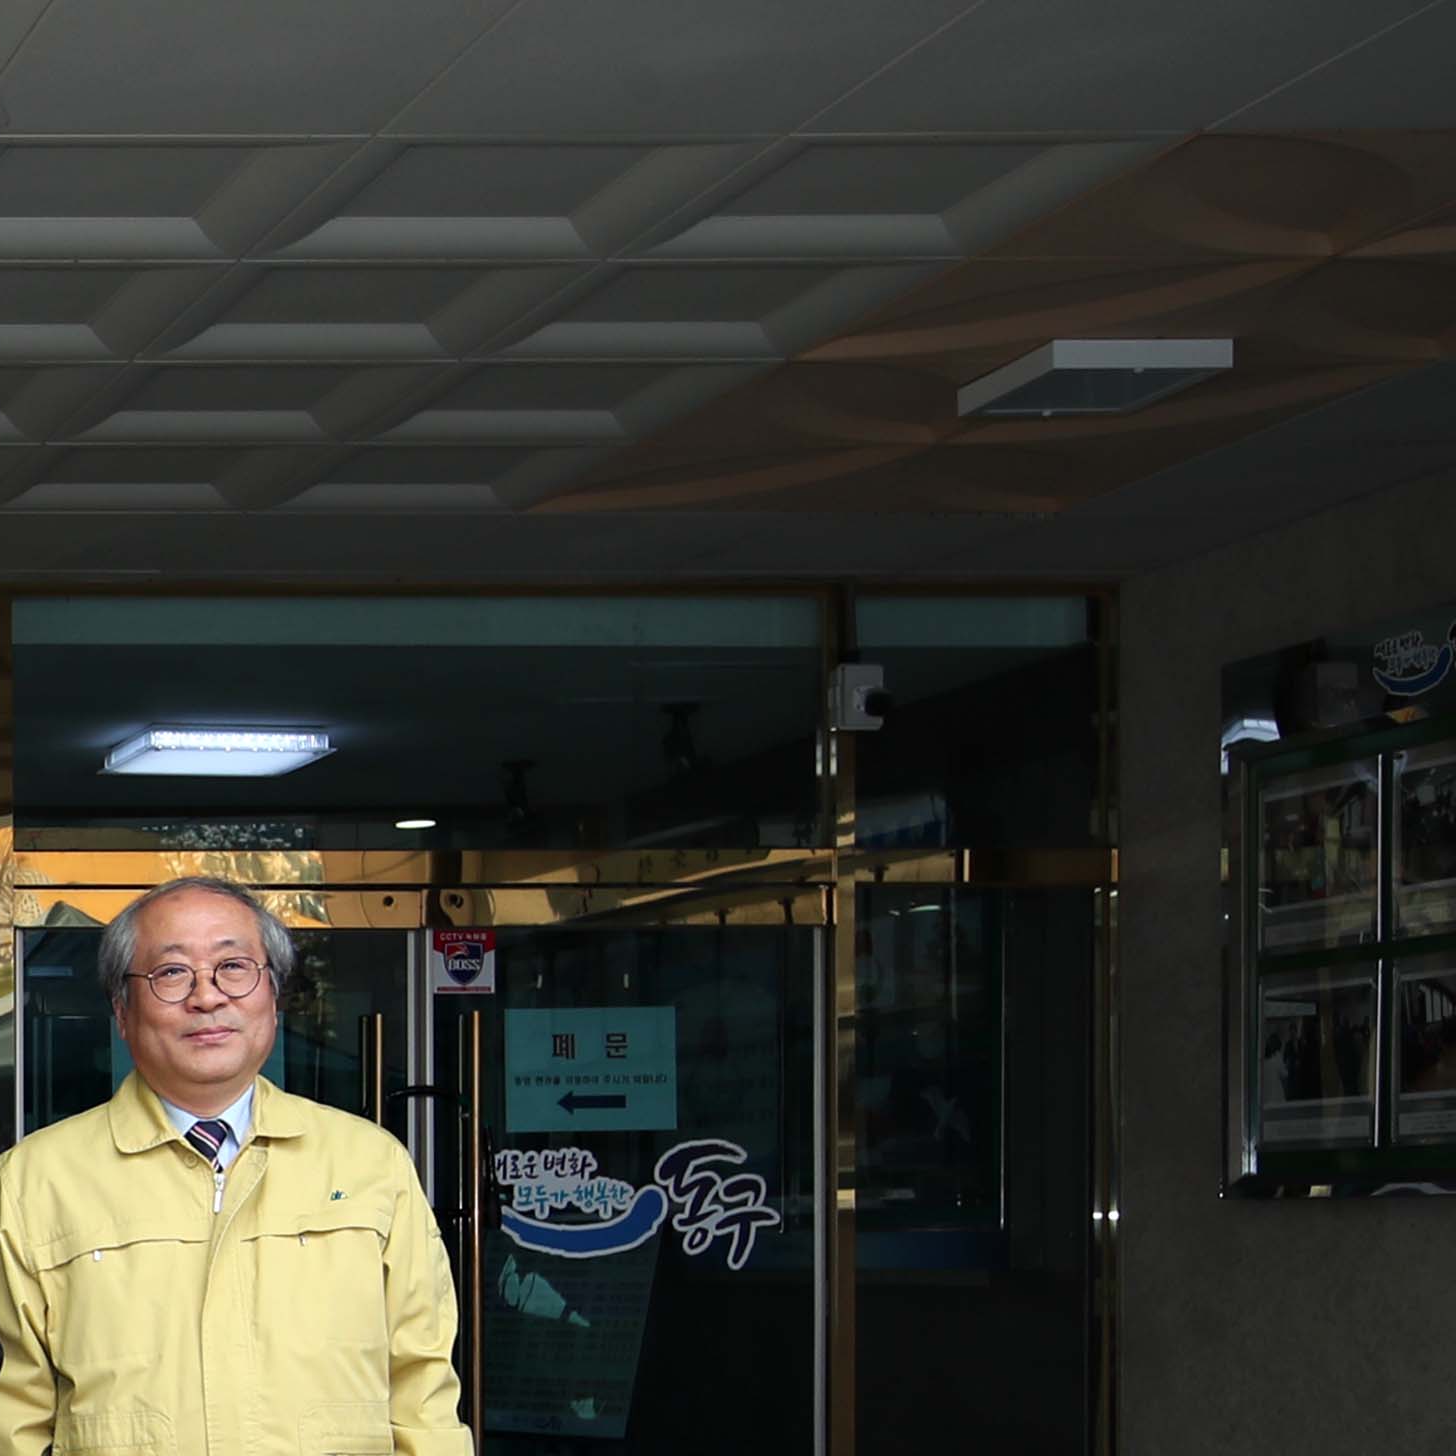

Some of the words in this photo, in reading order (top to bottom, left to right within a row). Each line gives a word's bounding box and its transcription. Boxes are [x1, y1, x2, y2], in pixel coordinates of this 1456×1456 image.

[543, 1148, 596, 1180] 변화
[516, 1185, 568, 1217] 모두가
[572, 1180, 631, 1217] 행복한
[655, 1140, 780, 1270] 동구
